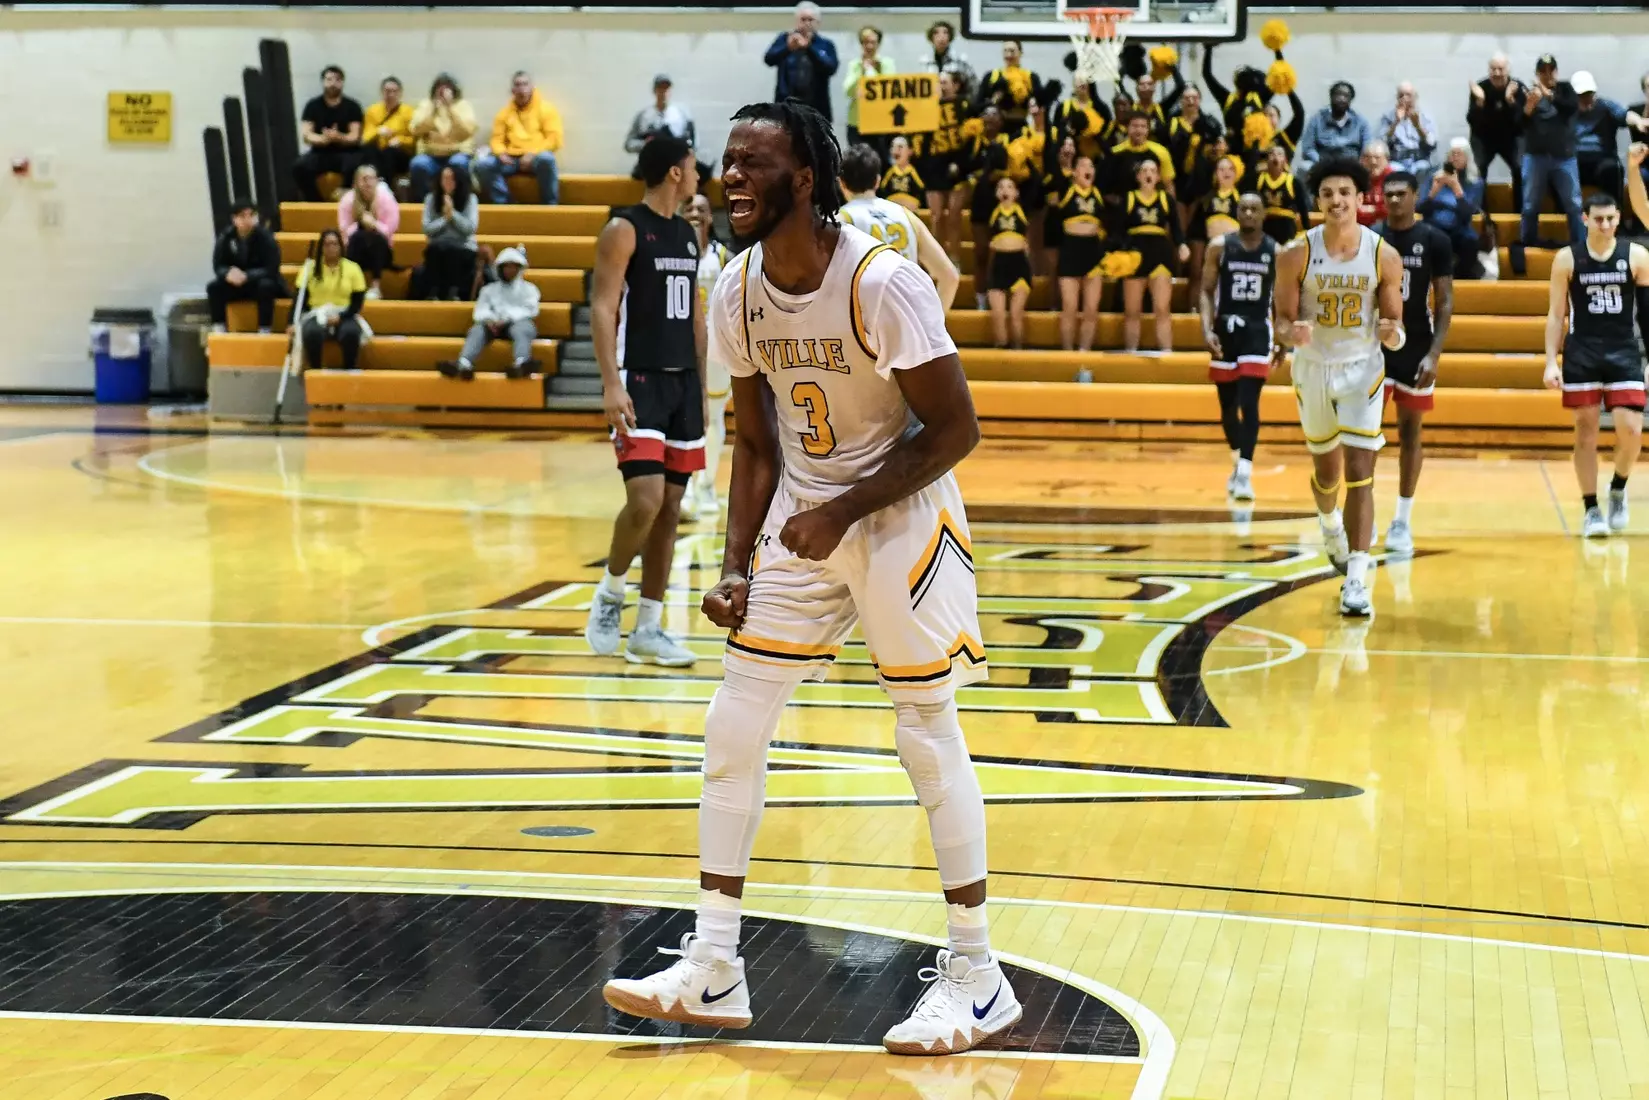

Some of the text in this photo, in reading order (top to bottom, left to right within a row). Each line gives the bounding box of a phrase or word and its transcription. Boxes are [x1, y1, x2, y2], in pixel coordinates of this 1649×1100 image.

[865, 78, 932, 100] STAND
[1231, 271, 1262, 301] 23
[1314, 272, 1370, 291] VILLE
[1579, 272, 1627, 285] WARRIORS
[666, 274, 690, 319] 10
[1316, 292, 1362, 328] 32
[1586, 284, 1623, 314] 30
[756, 338, 851, 375] VILLE
[791, 381, 837, 456] 3
